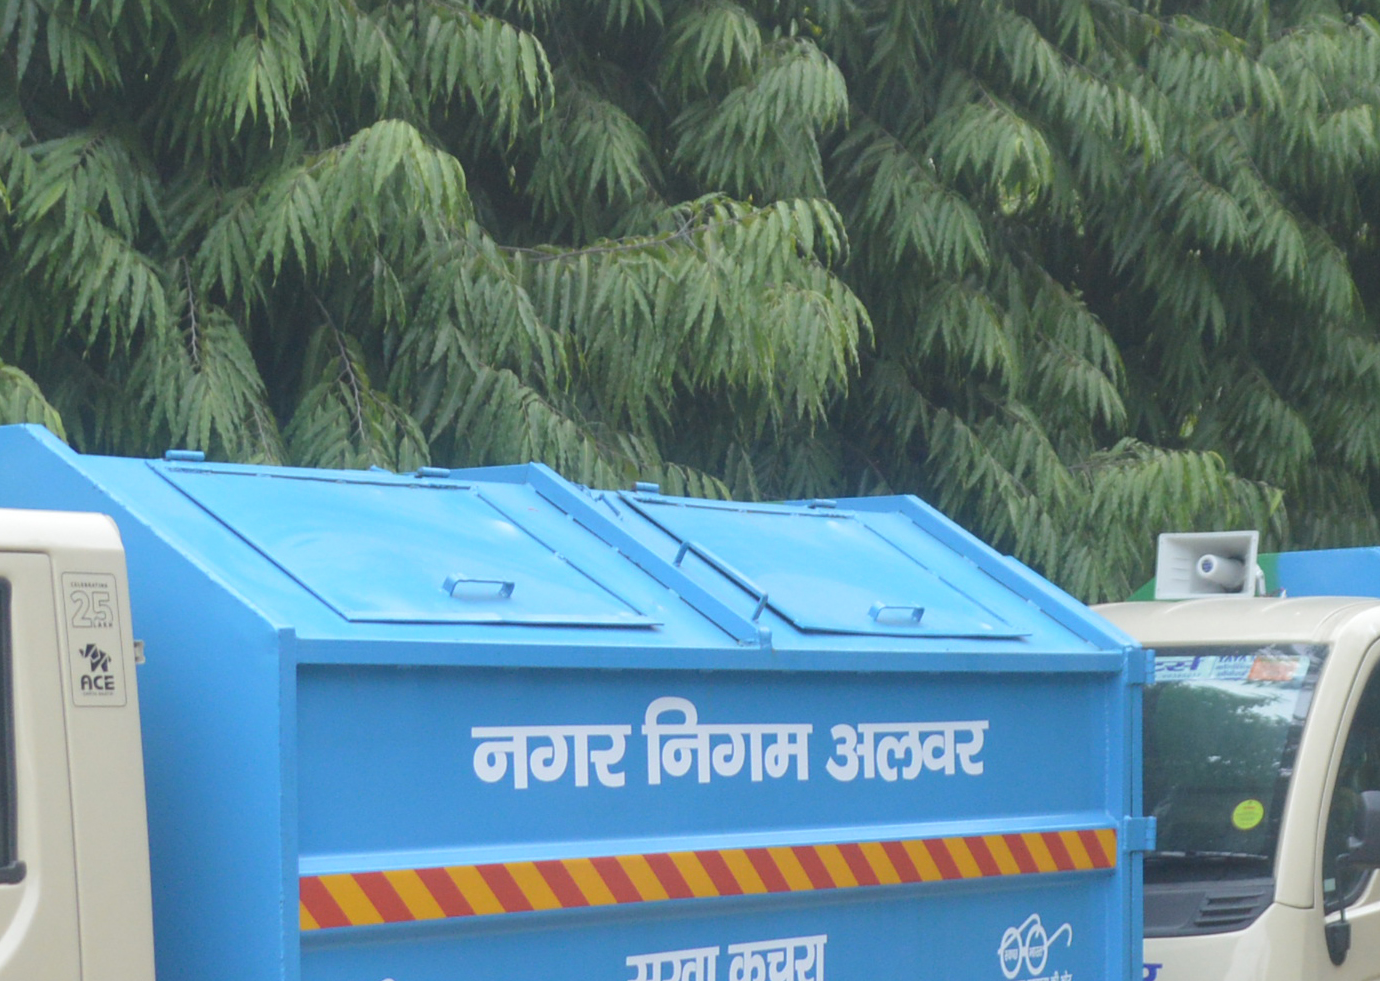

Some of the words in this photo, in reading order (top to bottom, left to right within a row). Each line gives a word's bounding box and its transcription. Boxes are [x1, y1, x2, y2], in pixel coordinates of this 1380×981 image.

[70, 589, 114, 628] 25
[80, 674, 115, 691] ACE
[471, 724, 631, 789] नगर
[641, 695, 812, 785] निगम
[825, 719, 989, 782] अलवर
